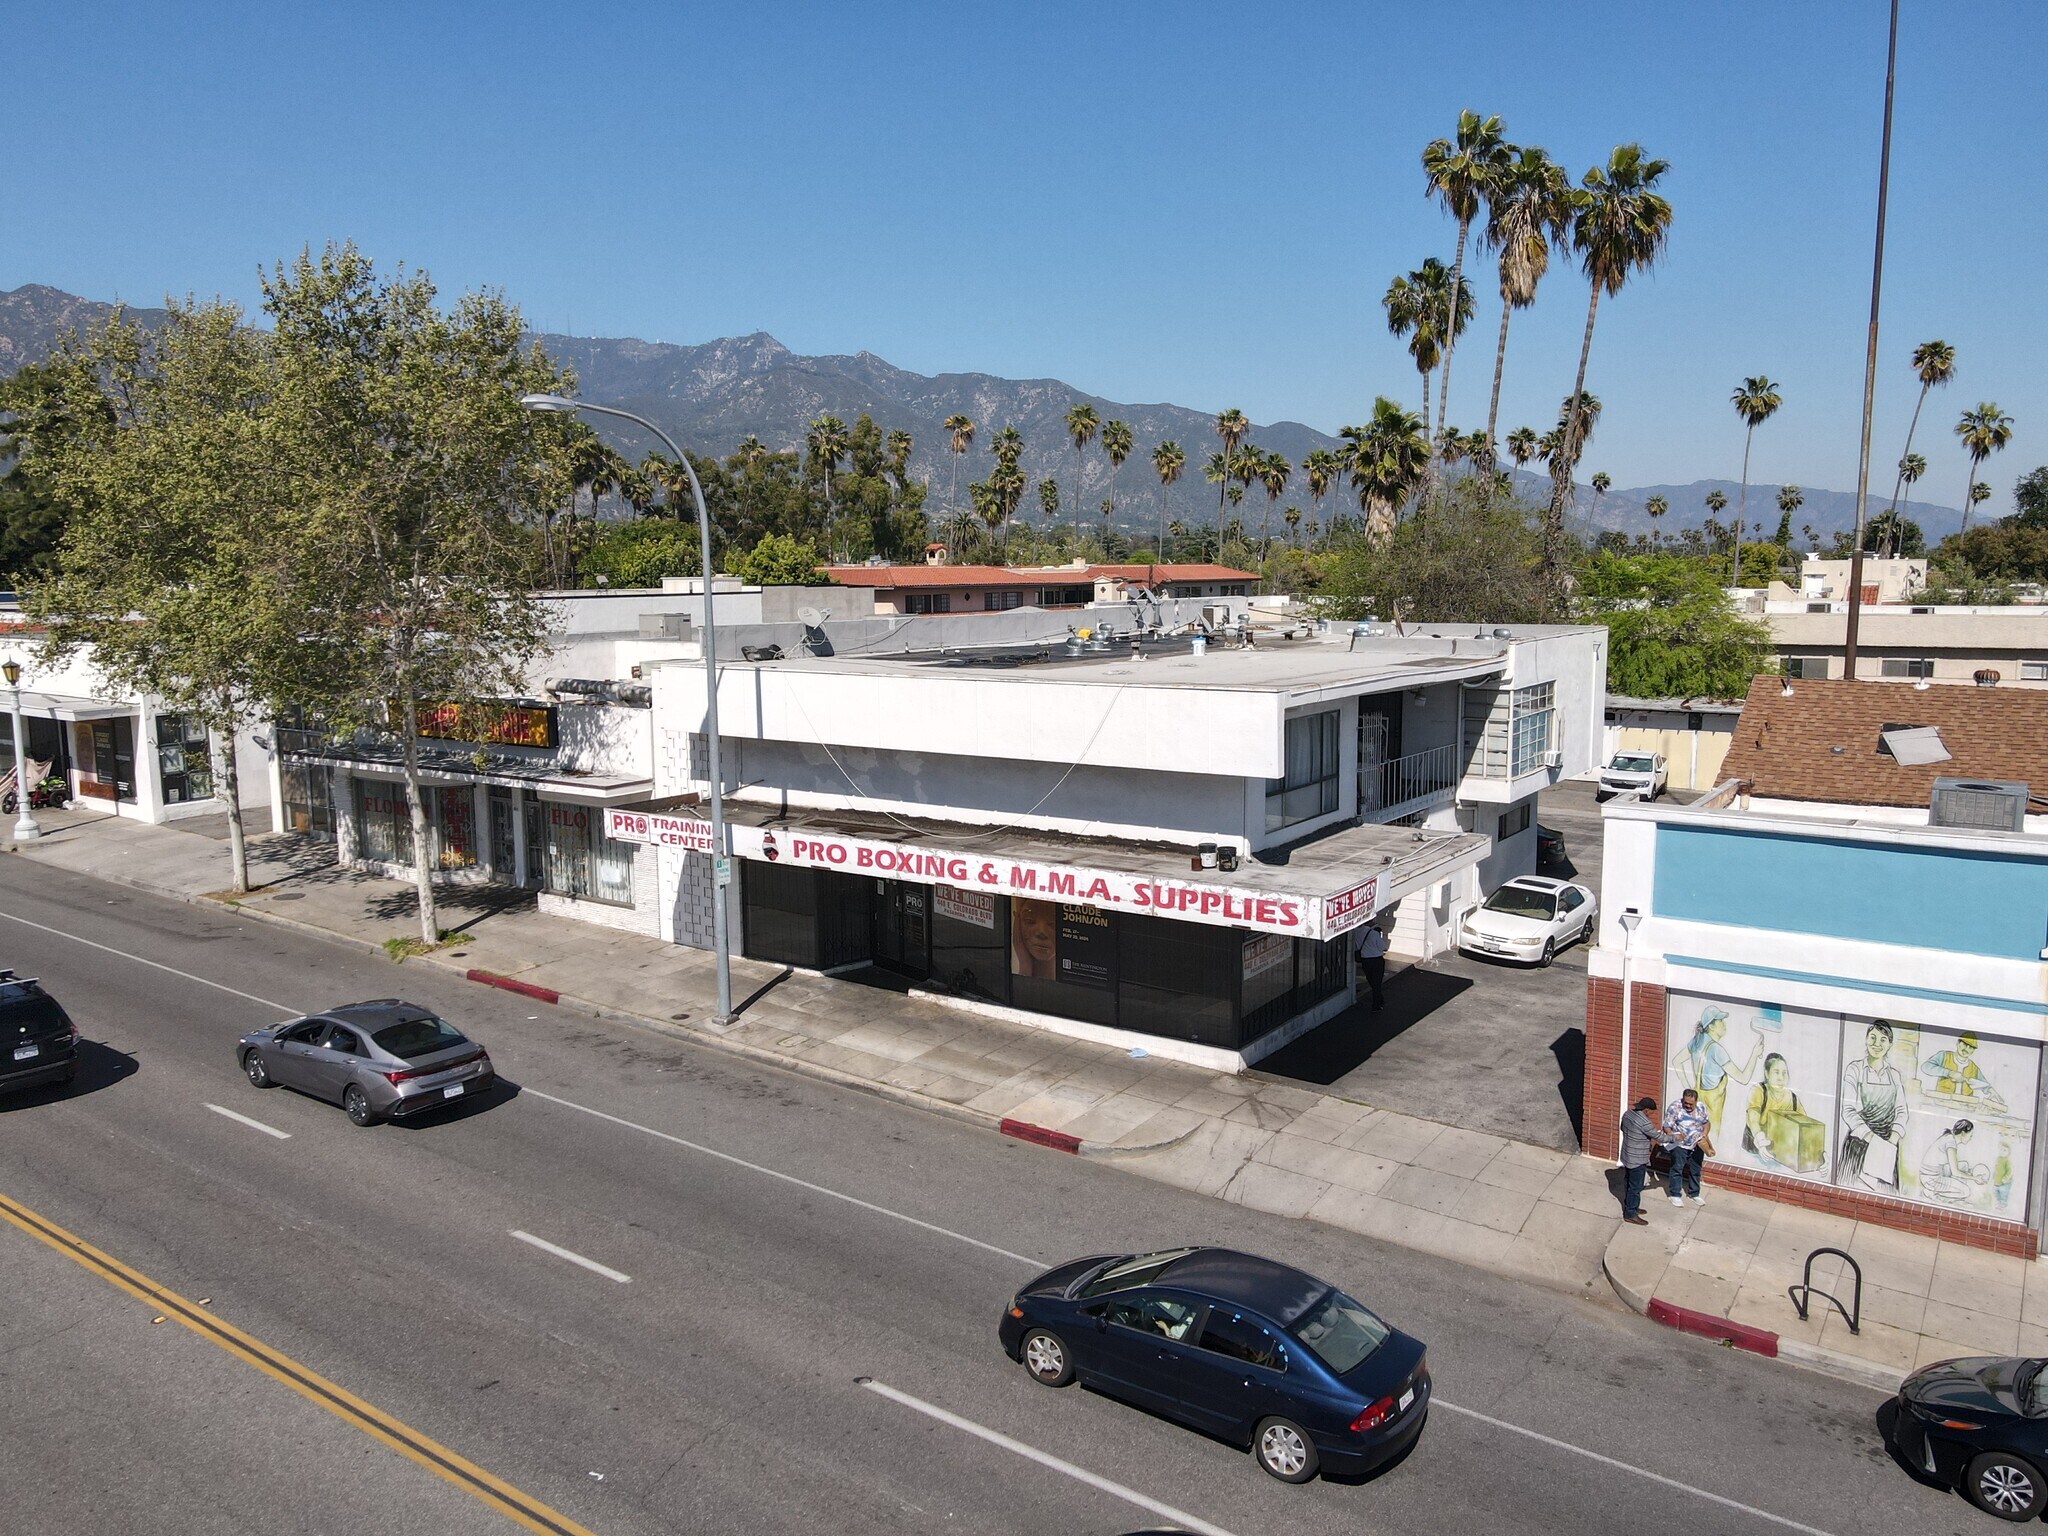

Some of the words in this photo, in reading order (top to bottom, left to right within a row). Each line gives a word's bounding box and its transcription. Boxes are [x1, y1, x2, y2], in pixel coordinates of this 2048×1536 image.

[651, 817, 713, 836] TRAININ
[793, 839, 848, 864] PRO
[856, 846, 967, 880] BOXING
[977, 863, 999, 885] &
[1010, 866, 1121, 902] M.M.A.
[1133, 883, 1299, 926] SUPPLIES
[905, 895, 923, 908] PRO
[962, 891, 993, 911] MOVED!
[1062, 904, 1102, 917] CLAUDE
[1062, 912, 1108, 928] JOHNSON
